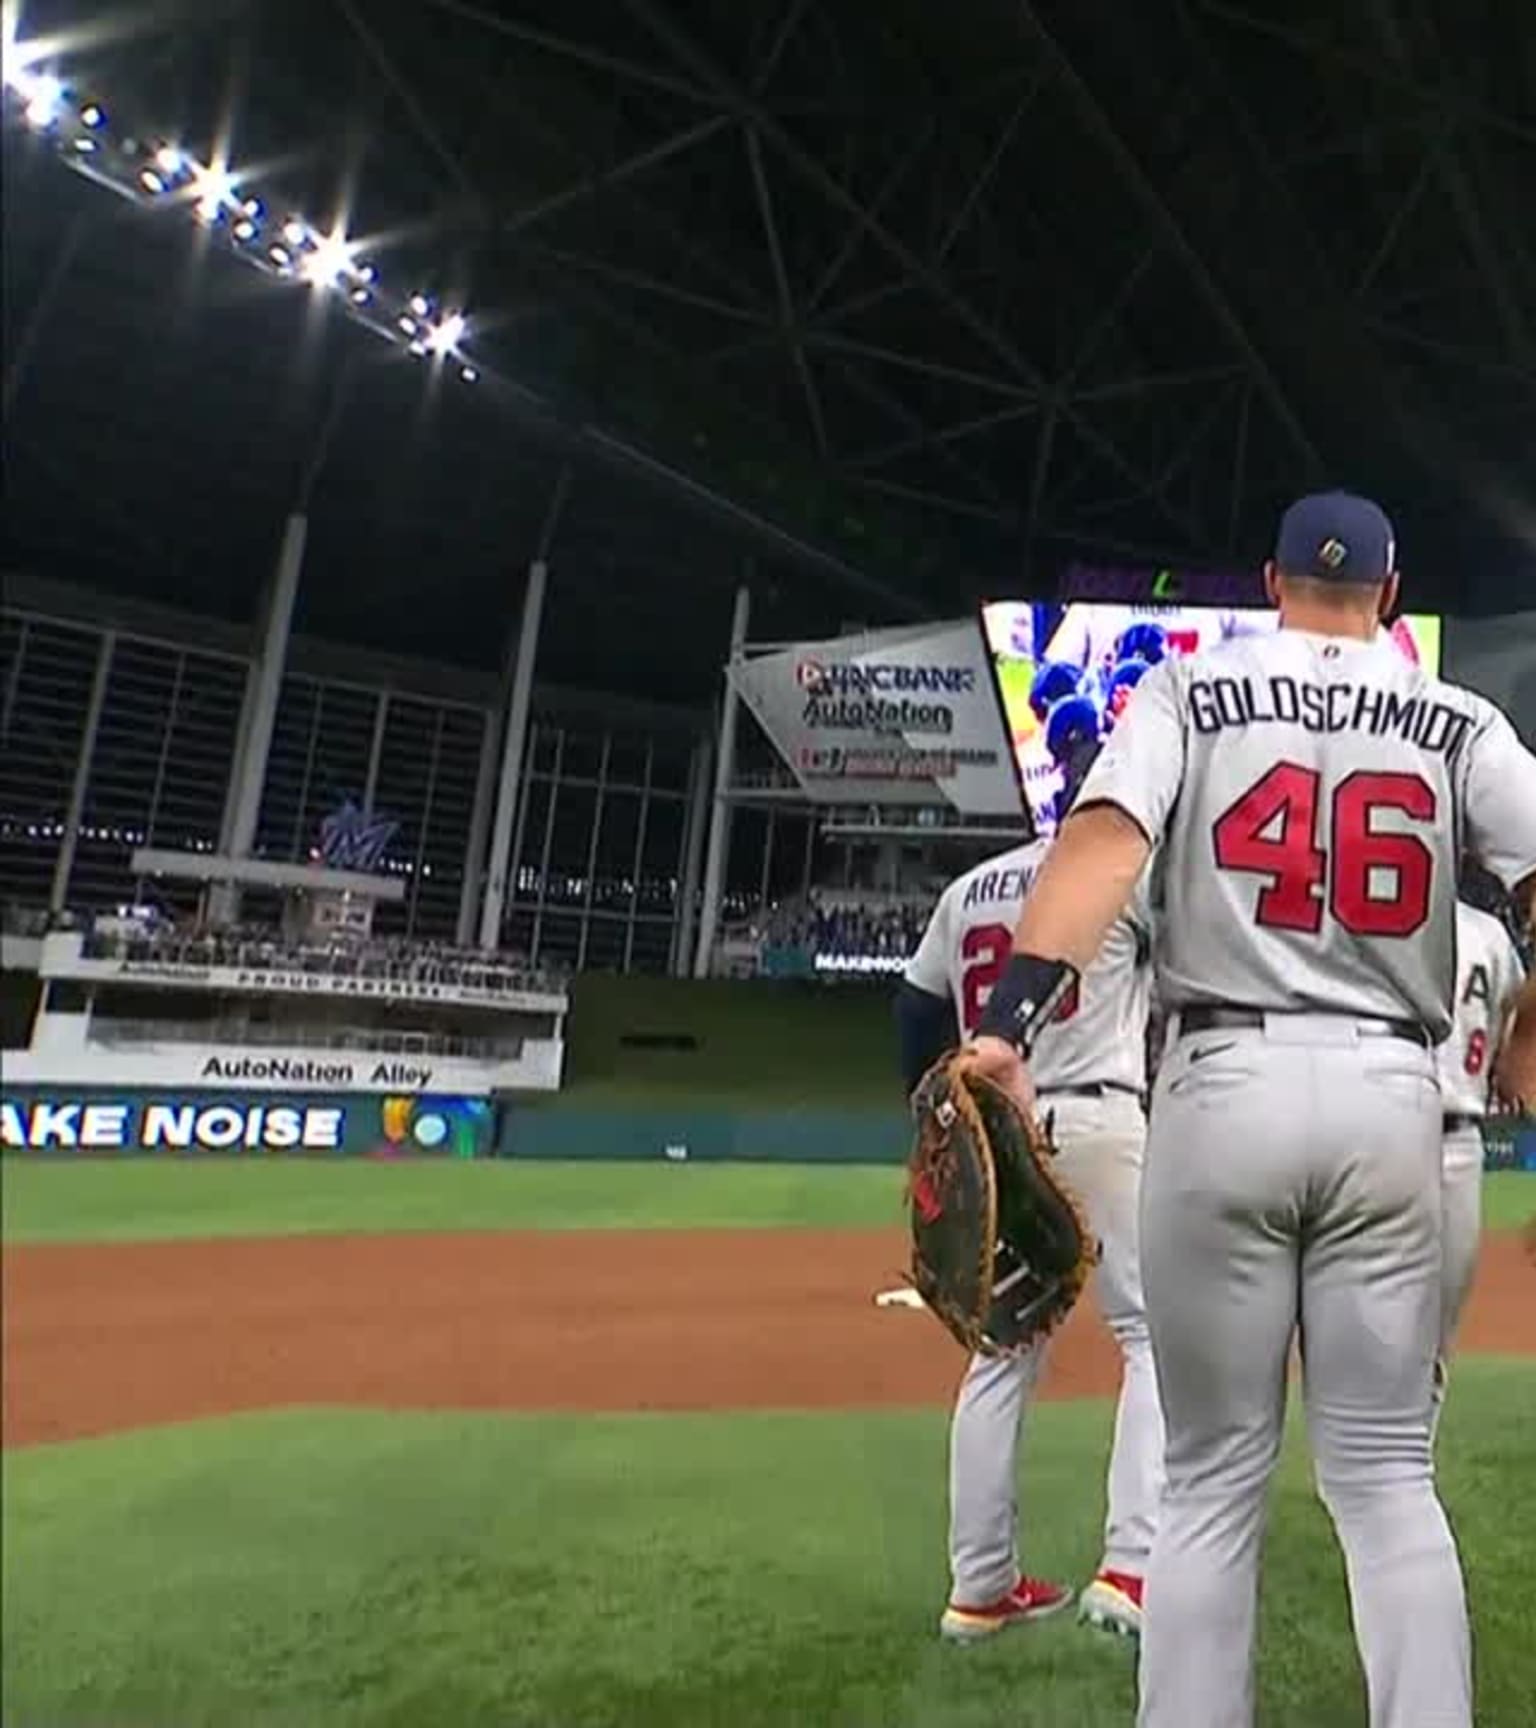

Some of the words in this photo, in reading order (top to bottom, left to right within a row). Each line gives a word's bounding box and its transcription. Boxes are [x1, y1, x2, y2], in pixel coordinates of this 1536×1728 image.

[1188, 675, 1477, 764] GOLDSCHMIDT
[1212, 760, 1437, 938] 46
[963, 867, 1037, 911] AREN
[202, 1057, 353, 1084] AutoNation
[371, 1063, 432, 1087] Alley
[0, 1106, 127, 1146] AKE
[142, 1107, 342, 1146] NOISE
